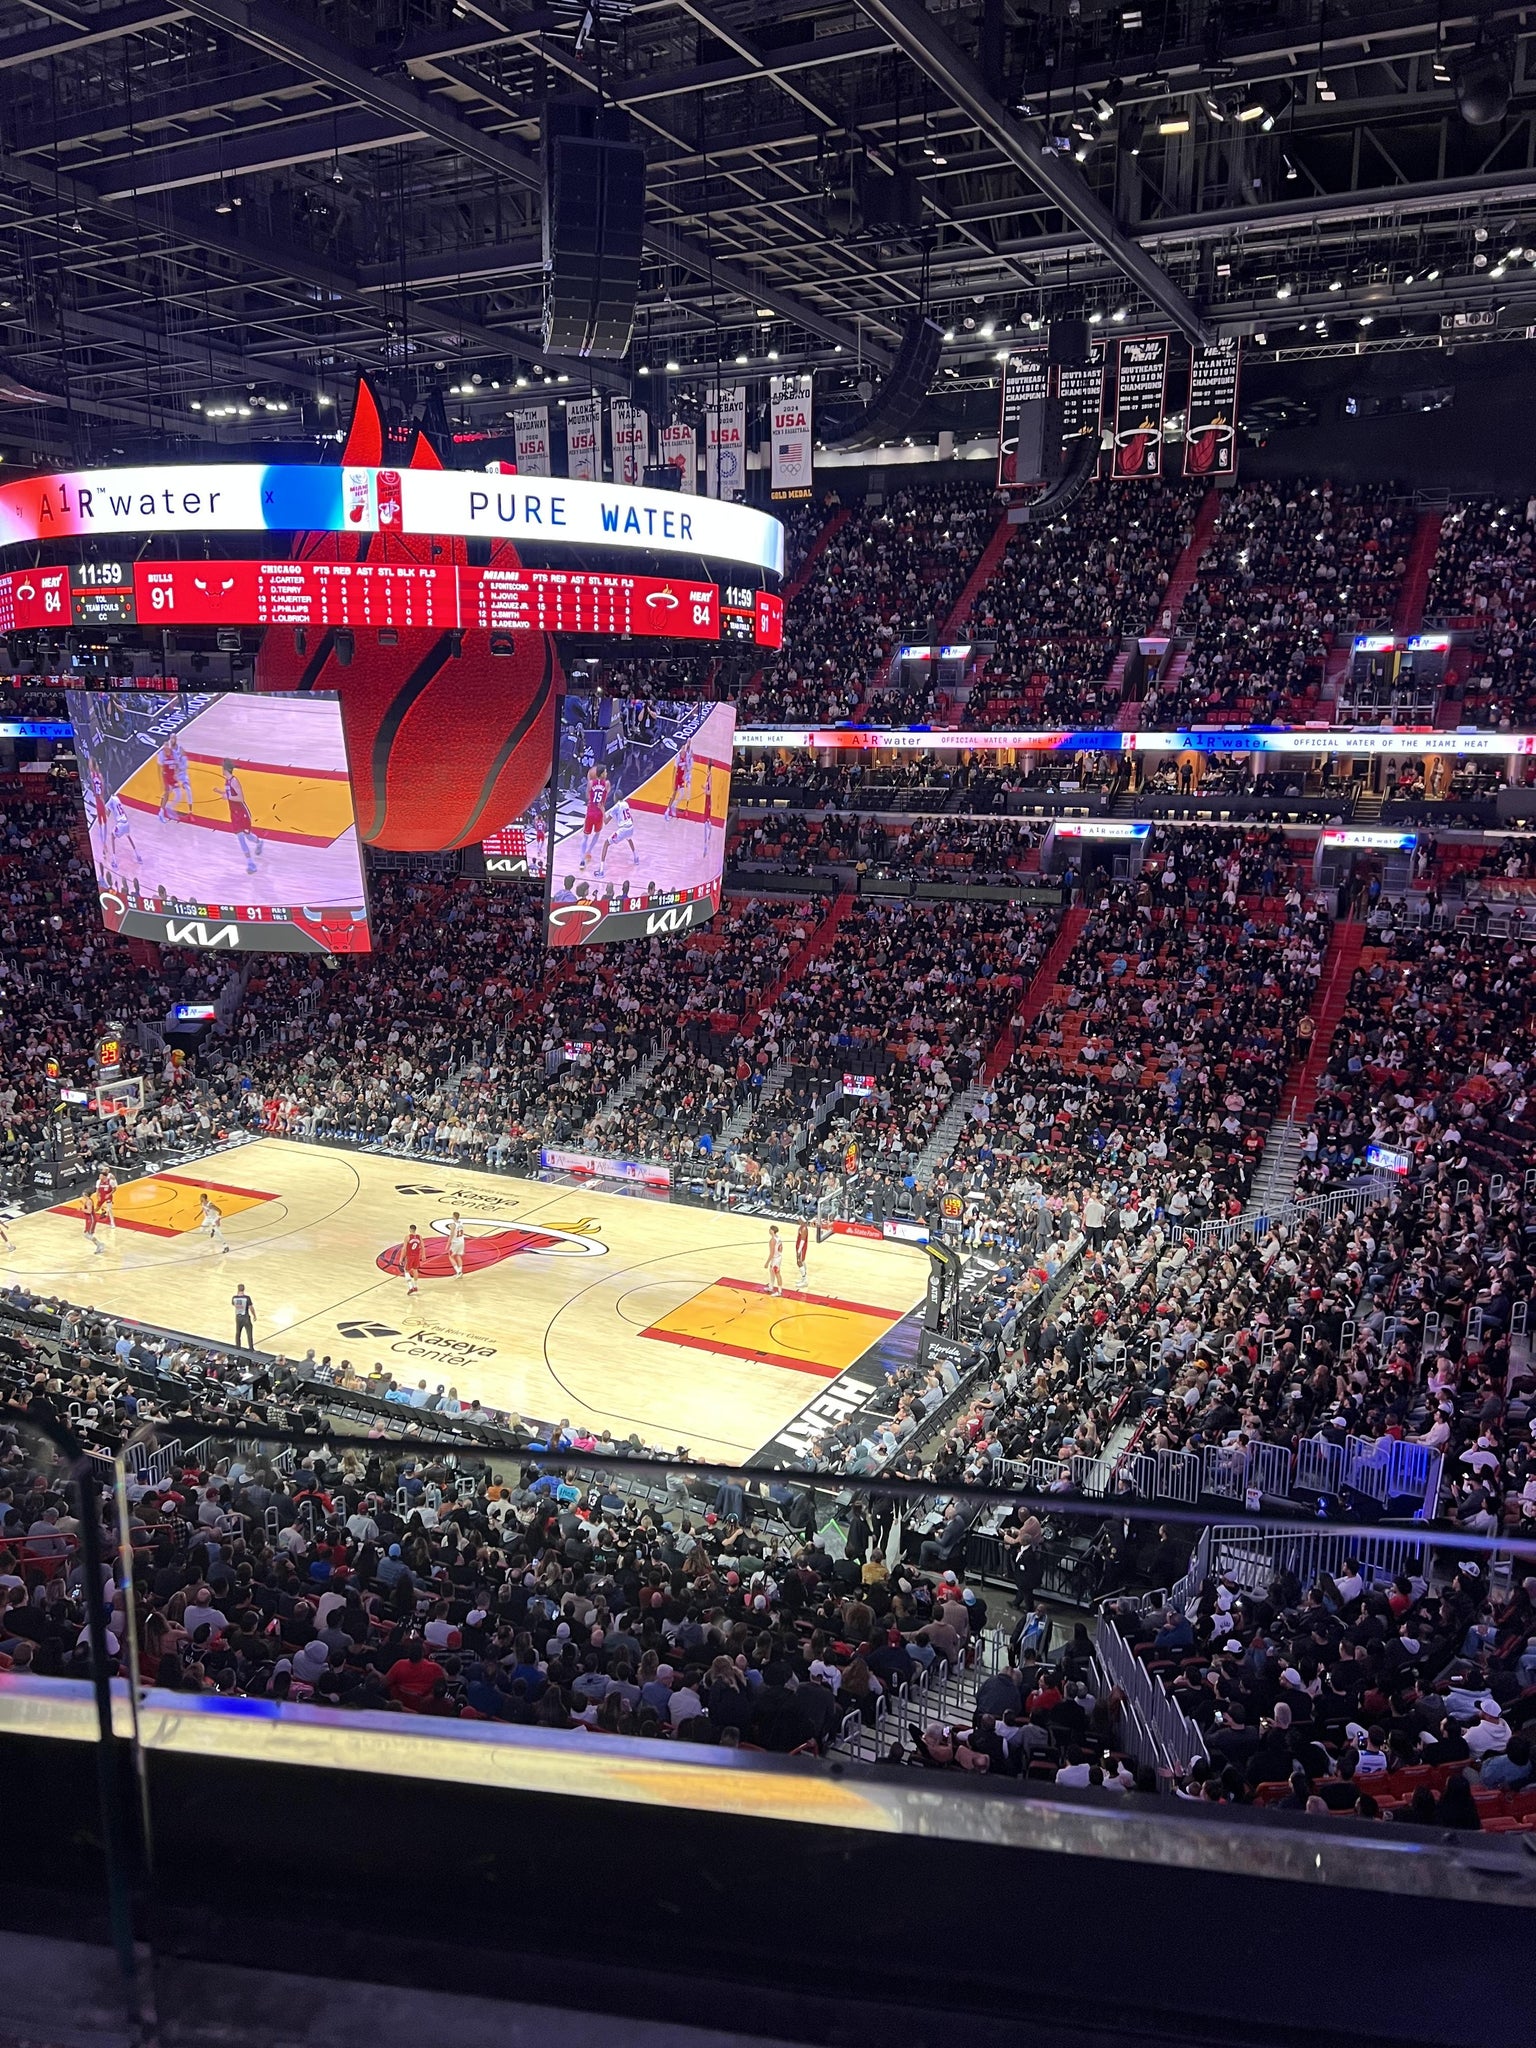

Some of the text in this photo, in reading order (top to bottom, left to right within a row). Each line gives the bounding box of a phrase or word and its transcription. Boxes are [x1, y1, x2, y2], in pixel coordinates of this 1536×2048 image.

[1121, 364, 1163, 375] SOUTHEAST
[1193, 359, 1237, 369] ATLANTIC
[1120, 373, 1163, 383] DIVISION
[1193, 367, 1236, 378] DIVISION
[1120, 381, 1162, 392] CHAMPIONS
[1192, 377, 1235, 387] CHAMPIONS
[525, 411, 537, 421] TIM
[776, 413, 807, 428] USA
[516, 419, 547, 431] HARDAWAY
[616, 430, 643, 444] USA
[663, 426, 691, 441] USA
[711, 428, 740, 443] USA
[520, 441, 545, 454] USA
[571, 435, 597, 449] USA
[771, 489, 813, 500] GOLD MEDAL
[109, 489, 221, 517] water
[469, 491, 693, 541] PURE WATER
[79, 563, 122, 584] 11:59
[147, 573, 173, 583] BULLS
[261, 565, 436, 578] CHICAGO PTS REB AST STL BLK FLS
[42, 573, 63, 588] HEAT
[483, 570, 634, 587] MIAMI PTS REB AST STL BLK FLS
[152, 587, 174, 609] 91
[385, 588, 391, 596] 0
[538, 594, 543, 602] 2
[689, 590, 713, 602] HEAT
[726, 586, 752, 607] 11:59
[45, 591, 61, 612] 84
[85, 603, 119, 612] TEAM FOULS
[98, 612, 108, 621] CC
[322, 615, 328, 623] 2
[343, 616, 348, 624] 3
[387, 617, 392, 625] 0
[406, 617, 412, 625] 0
[427, 618, 432, 626] 2
[478, 610, 487, 618] 12
[693, 605, 710, 625] 84
[594, 623, 599, 631] 0
[609, 624, 614, 632] 0
[761, 614, 768, 632] 91
[884, 736, 921, 746] water
[1222, 737, 1268, 748] water
[1346, 739, 1376, 747] WATER
[1425, 740, 1457, 748] MIAMI
[1464, 740, 1489, 748] HEAT
[591, 791, 604, 803] 15
[143, 898, 156, 912] 84
[174, 903, 198, 916] 11:59
[198, 907, 207, 916] 23
[246, 906, 262, 920] 91
[629, 898, 641, 911] 84
[101, 1050, 117, 1064] 23
[437, 1196, 506, 1212] Center
[450, 1189, 520, 1207] Kaseya
[944, 1206, 959, 1216] 23
[407, 1330, 498, 1357] Kaseya
[928, 1343, 961, 1357] Florida
[390, 1340, 479, 1367] Center
